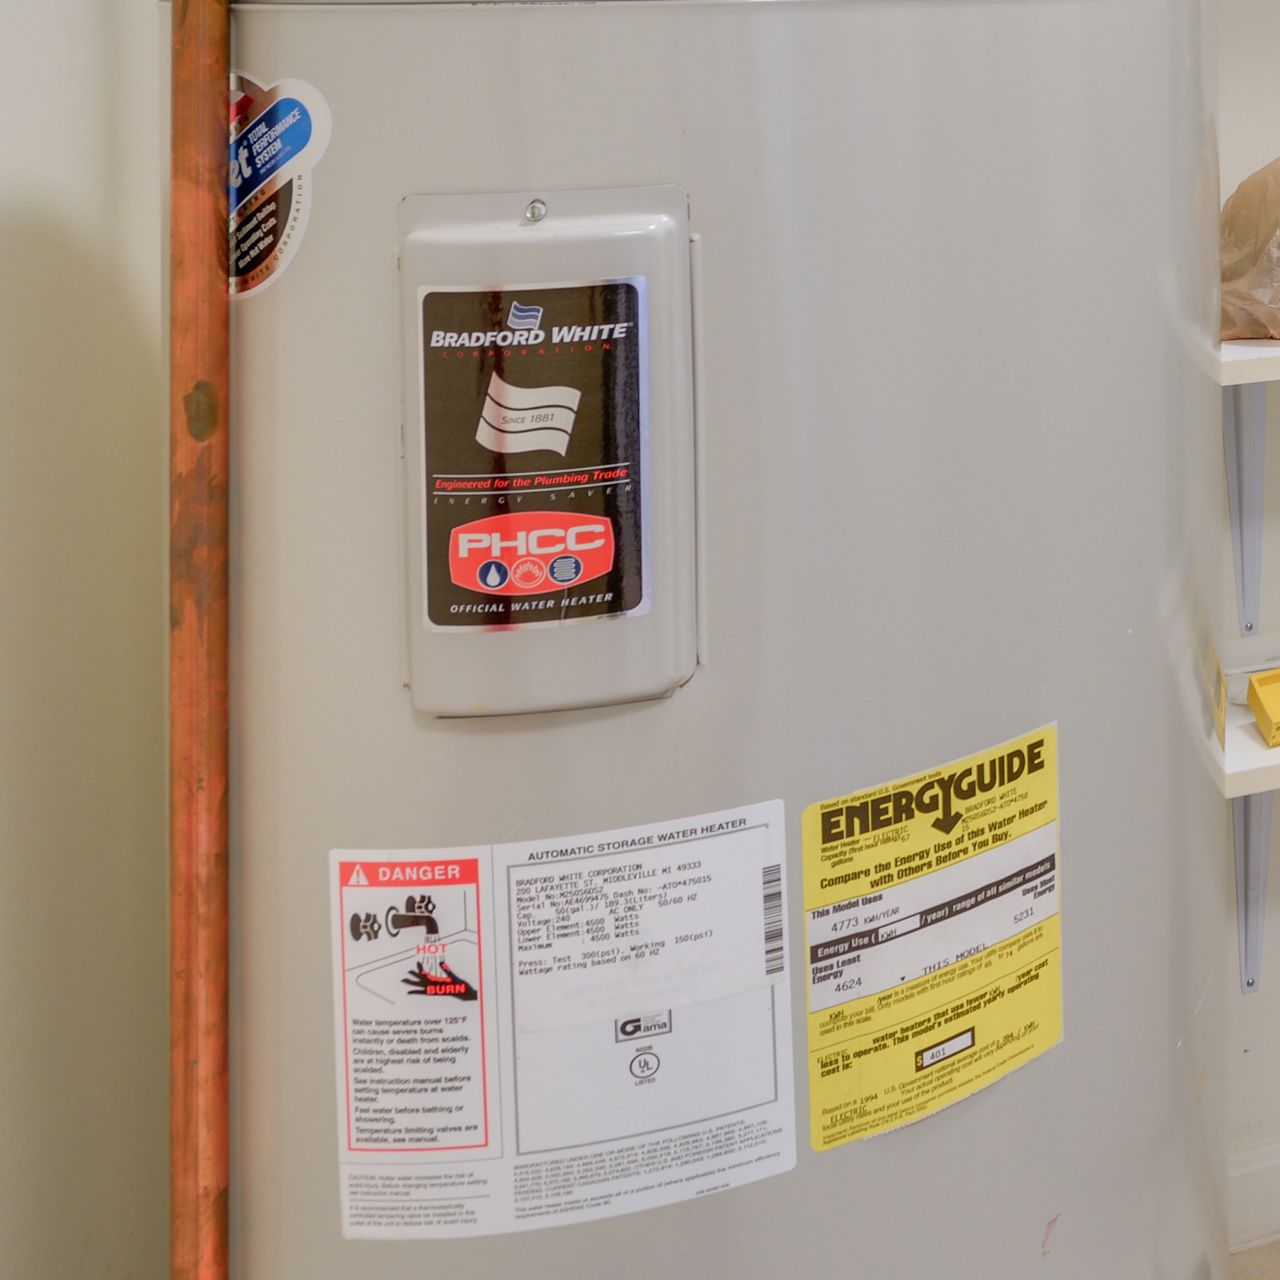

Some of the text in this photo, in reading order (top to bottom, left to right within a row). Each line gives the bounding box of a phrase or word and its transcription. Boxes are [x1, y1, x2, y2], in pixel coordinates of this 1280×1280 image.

[247, 121, 269, 144] TOTAL
[252, 107, 302, 156] PERFORMANCE
[254, 138, 283, 169] SYSTEM
[273, 174, 303, 261] CORPORATION
[430, 322, 629, 348] BRADFORD WHITE
[442, 343, 612, 358] CORPORATION
[530, 413, 555, 424] 1881
[435, 467, 628, 492] Engineered for the Plumbing Trade
[433, 484, 632, 505] ENERGY SAVER
[458, 524, 606, 559] PHCC
[450, 592, 614, 614] OFFICIAL WATER HEATER
[820, 738, 1045, 846] ENERGYGUIDE
[528, 818, 747, 861] AUTOMATIC STORAGE WATER HEATER
[820, 799, 1048, 890] Compare the Energy Use of this Water Heater
[869, 829, 1012, 890] with Others Before You Buy.
[378, 865, 460, 881] DANGER
[516, 863, 643, 887] BRADFORD WHITE CORPORATION
[516, 860, 702, 896] 200 LAFAYETTE MIDDLEVILLE MI 49333
[517, 892, 541, 904] Model
[952, 861, 1051, 914] range of all similar models
[812, 892, 883, 921] This Model Uses
[1013, 906, 1035, 925] 5231
[831, 916, 860, 933] 4773
[416, 944, 448, 954] HOT
[630, 939, 665, 953] Working
[817, 933, 870, 958] Energy Use
[812, 953, 861, 976] Uses Least
[922, 942, 989, 976] THIS MODEL
[812, 968, 844, 986] Energy
[834, 976, 862, 994] 4624
[427, 984, 466, 995] BURN
[916, 1047, 947, 1067] $ 401
[859, 1093, 878, 1106] 1994
